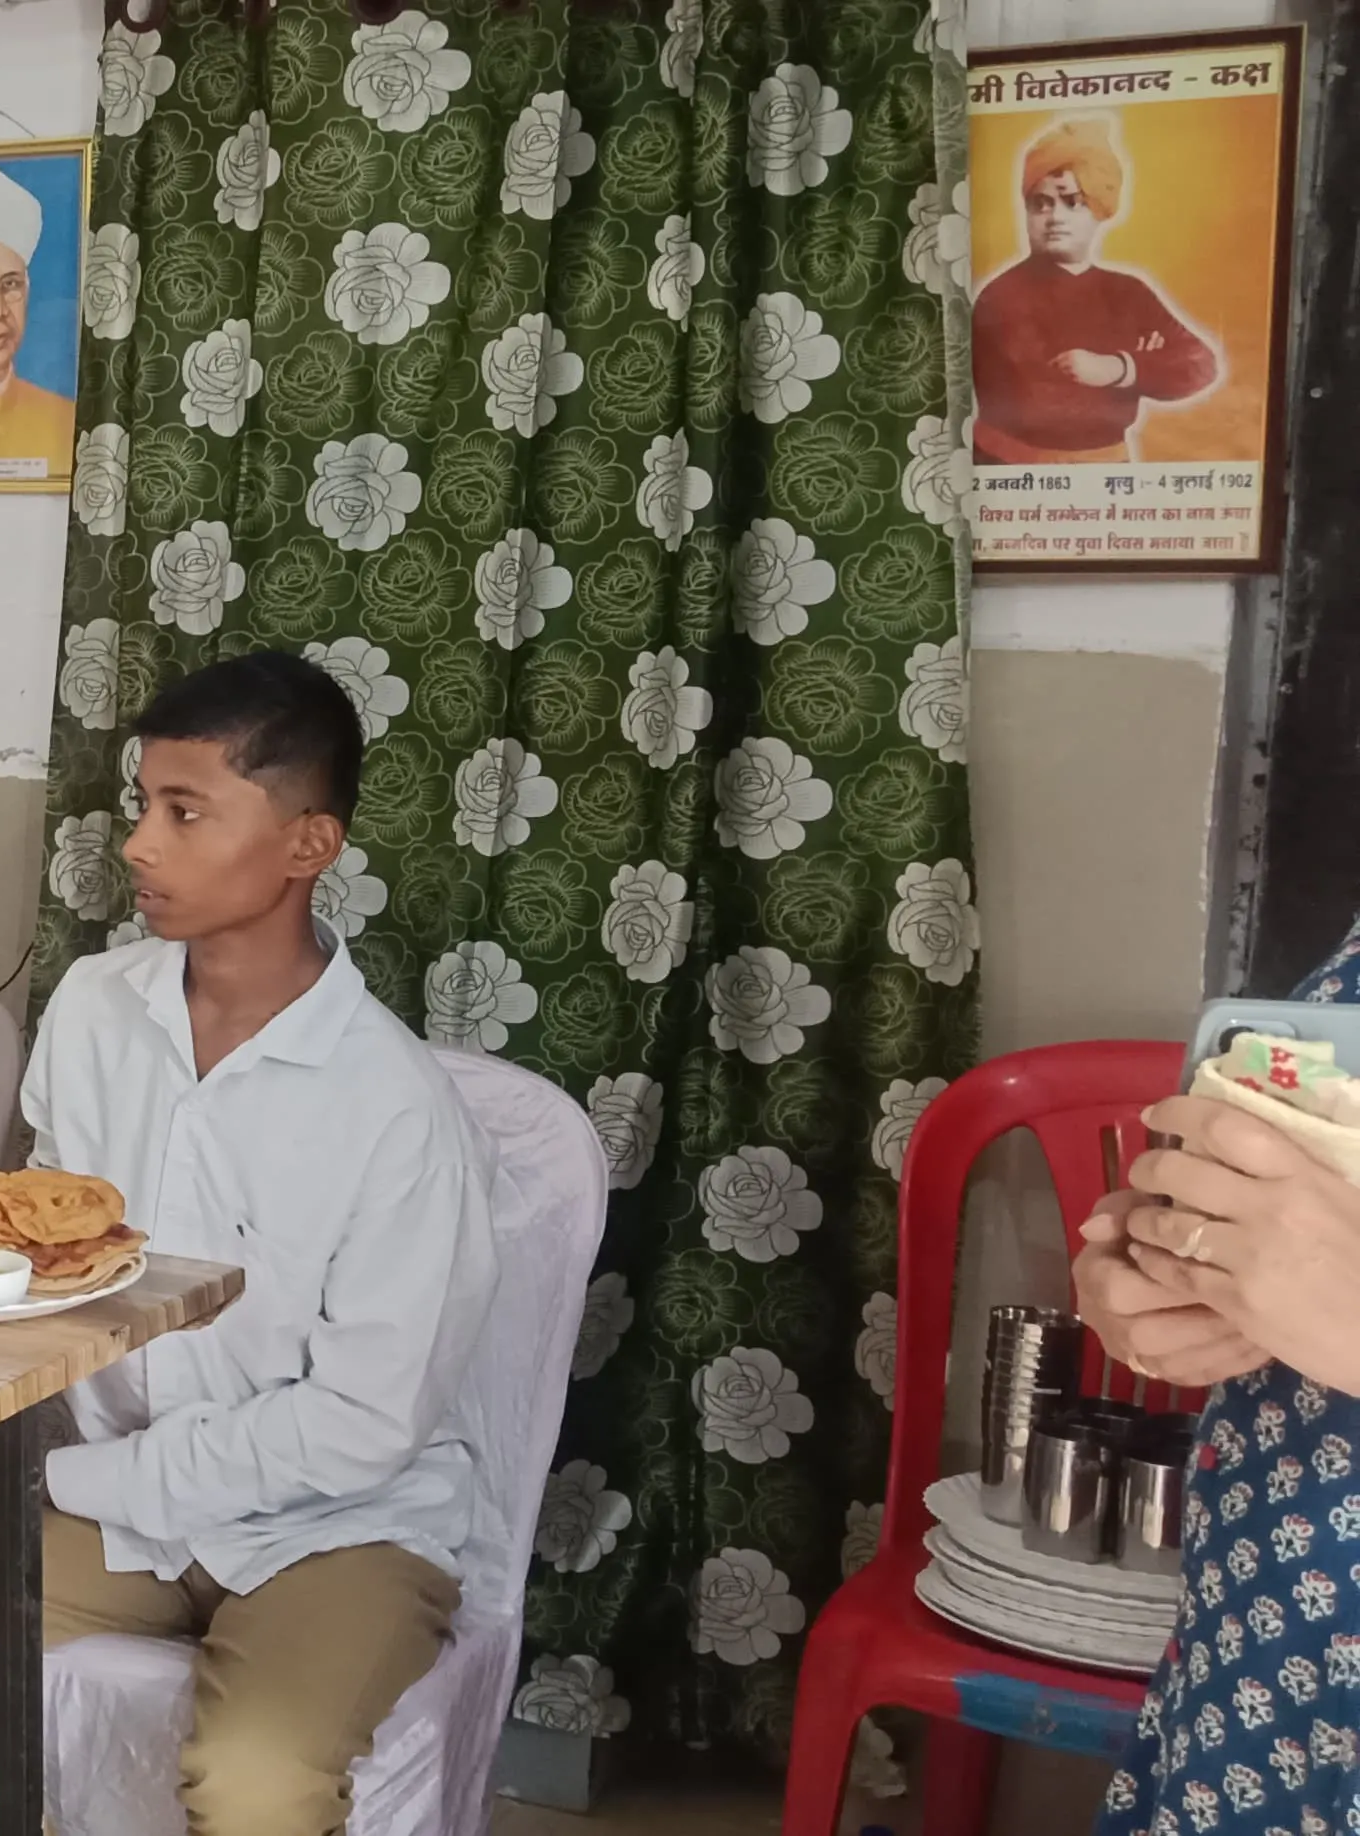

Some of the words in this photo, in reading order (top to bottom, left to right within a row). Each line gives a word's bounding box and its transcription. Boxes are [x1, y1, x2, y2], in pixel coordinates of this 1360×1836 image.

[1014, 69, 1174, 101] विवेकानन्द
[1209, 61, 1272, 87] कक्ष
[985, 472, 1034, 491] जनवरी
[1038, 476, 1071, 490] 1863
[1104, 475, 1134, 495] मृत्यु
[1158, 474, 1166, 489] 4
[1171, 468, 1215, 495] जुलाई
[1220, 473, 1253, 489] 1902
[979, 504, 1014, 523] विश्व
[1046, 503, 1101, 522] सम्मेलन
[1121, 507, 1157, 521] भारत
[1161, 507, 1182, 521] का
[992, 532, 1048, 550] जन्मदिन
[1052, 537, 1071, 550] पर
[1075, 536, 1102, 555] युवा
[1107, 531, 1144, 550] दिवस
[1149, 536, 1195, 550] मनाया
[1201, 536, 1234, 550] जाता
